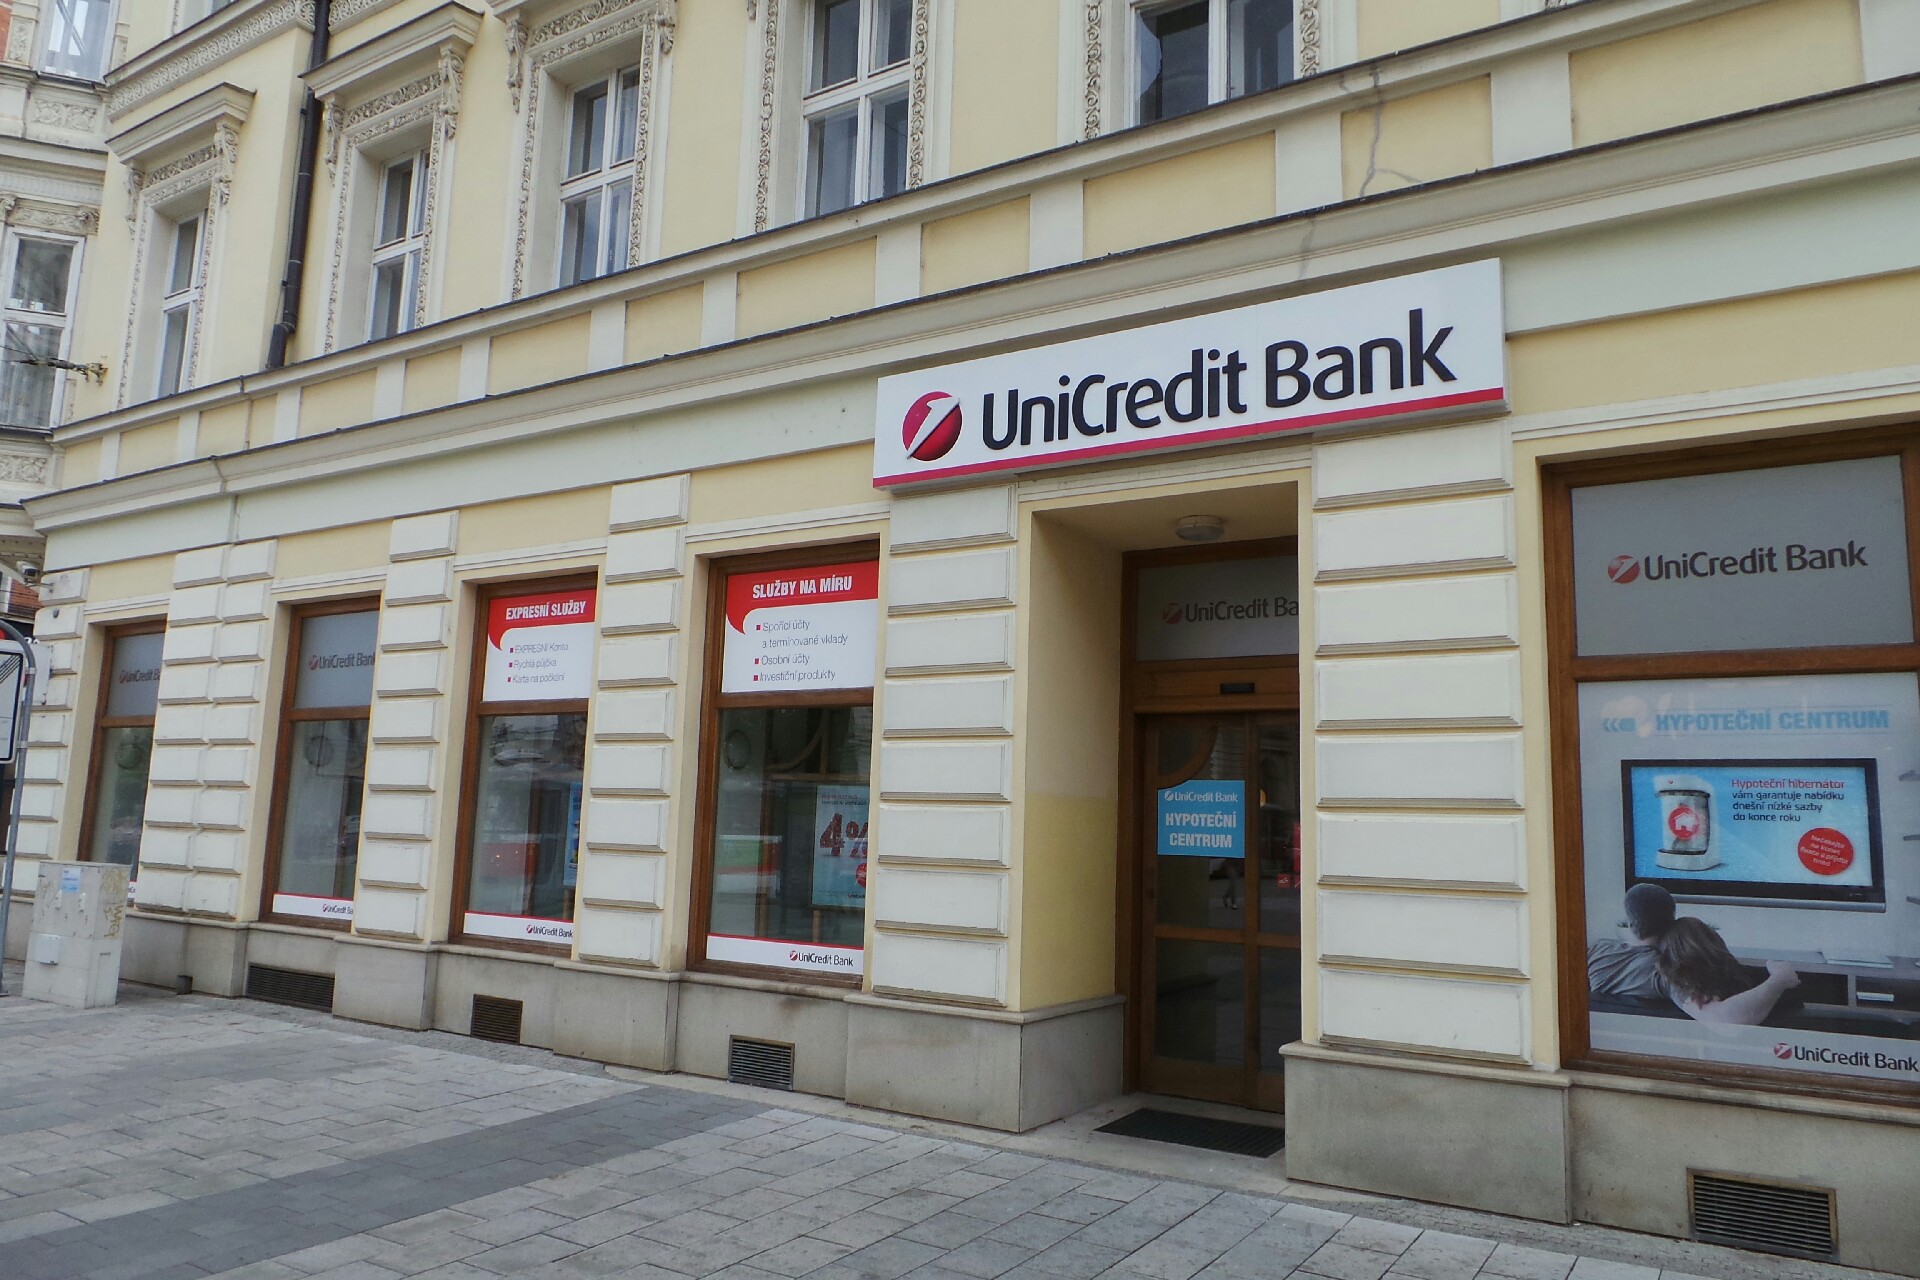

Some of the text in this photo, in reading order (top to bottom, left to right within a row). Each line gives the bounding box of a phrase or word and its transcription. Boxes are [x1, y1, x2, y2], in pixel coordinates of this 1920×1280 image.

[982, 308, 1457, 451] UniCredit Bank
[1644, 540, 1868, 581] UniCredit Bank
[752, 574, 853, 599] SLUŽBY NA MÍRU
[505, 600, 587, 620] EXPRESNÍ SLUŽBY
[1185, 598, 1269, 622] UniCredit
[792, 619, 811, 632] účty
[514, 643, 569, 654] EXPRESNÍ Konto
[762, 633, 849, 649] a termínované vklady
[319, 653, 355, 669] UniCredit
[761, 653, 810, 666] Osobní účty
[512, 675, 530, 684] Karta
[759, 669, 836, 683] Investiční produkty
[1655, 708, 1889, 732] HYPOTEČNÍ CENTRUM
[1731, 779, 1846, 790] Hypoteční hibernátor
[1174, 791, 1238, 803] UniCredit Bank
[1731, 790, 1845, 801] vám garantuje nabídku
[1732, 801, 1823, 813] dnešní nízké sazby
[1165, 810, 1237, 828] HYPOTEČNÍ
[1733, 812, 1801, 822] do konce roku
[1169, 832, 1233, 849] CENTRUM
[533, 925, 558, 936] UniCredit
[798, 952, 854, 967] UniCredit Bank
[1794, 1045, 1919, 1072] UniCredit Bank
